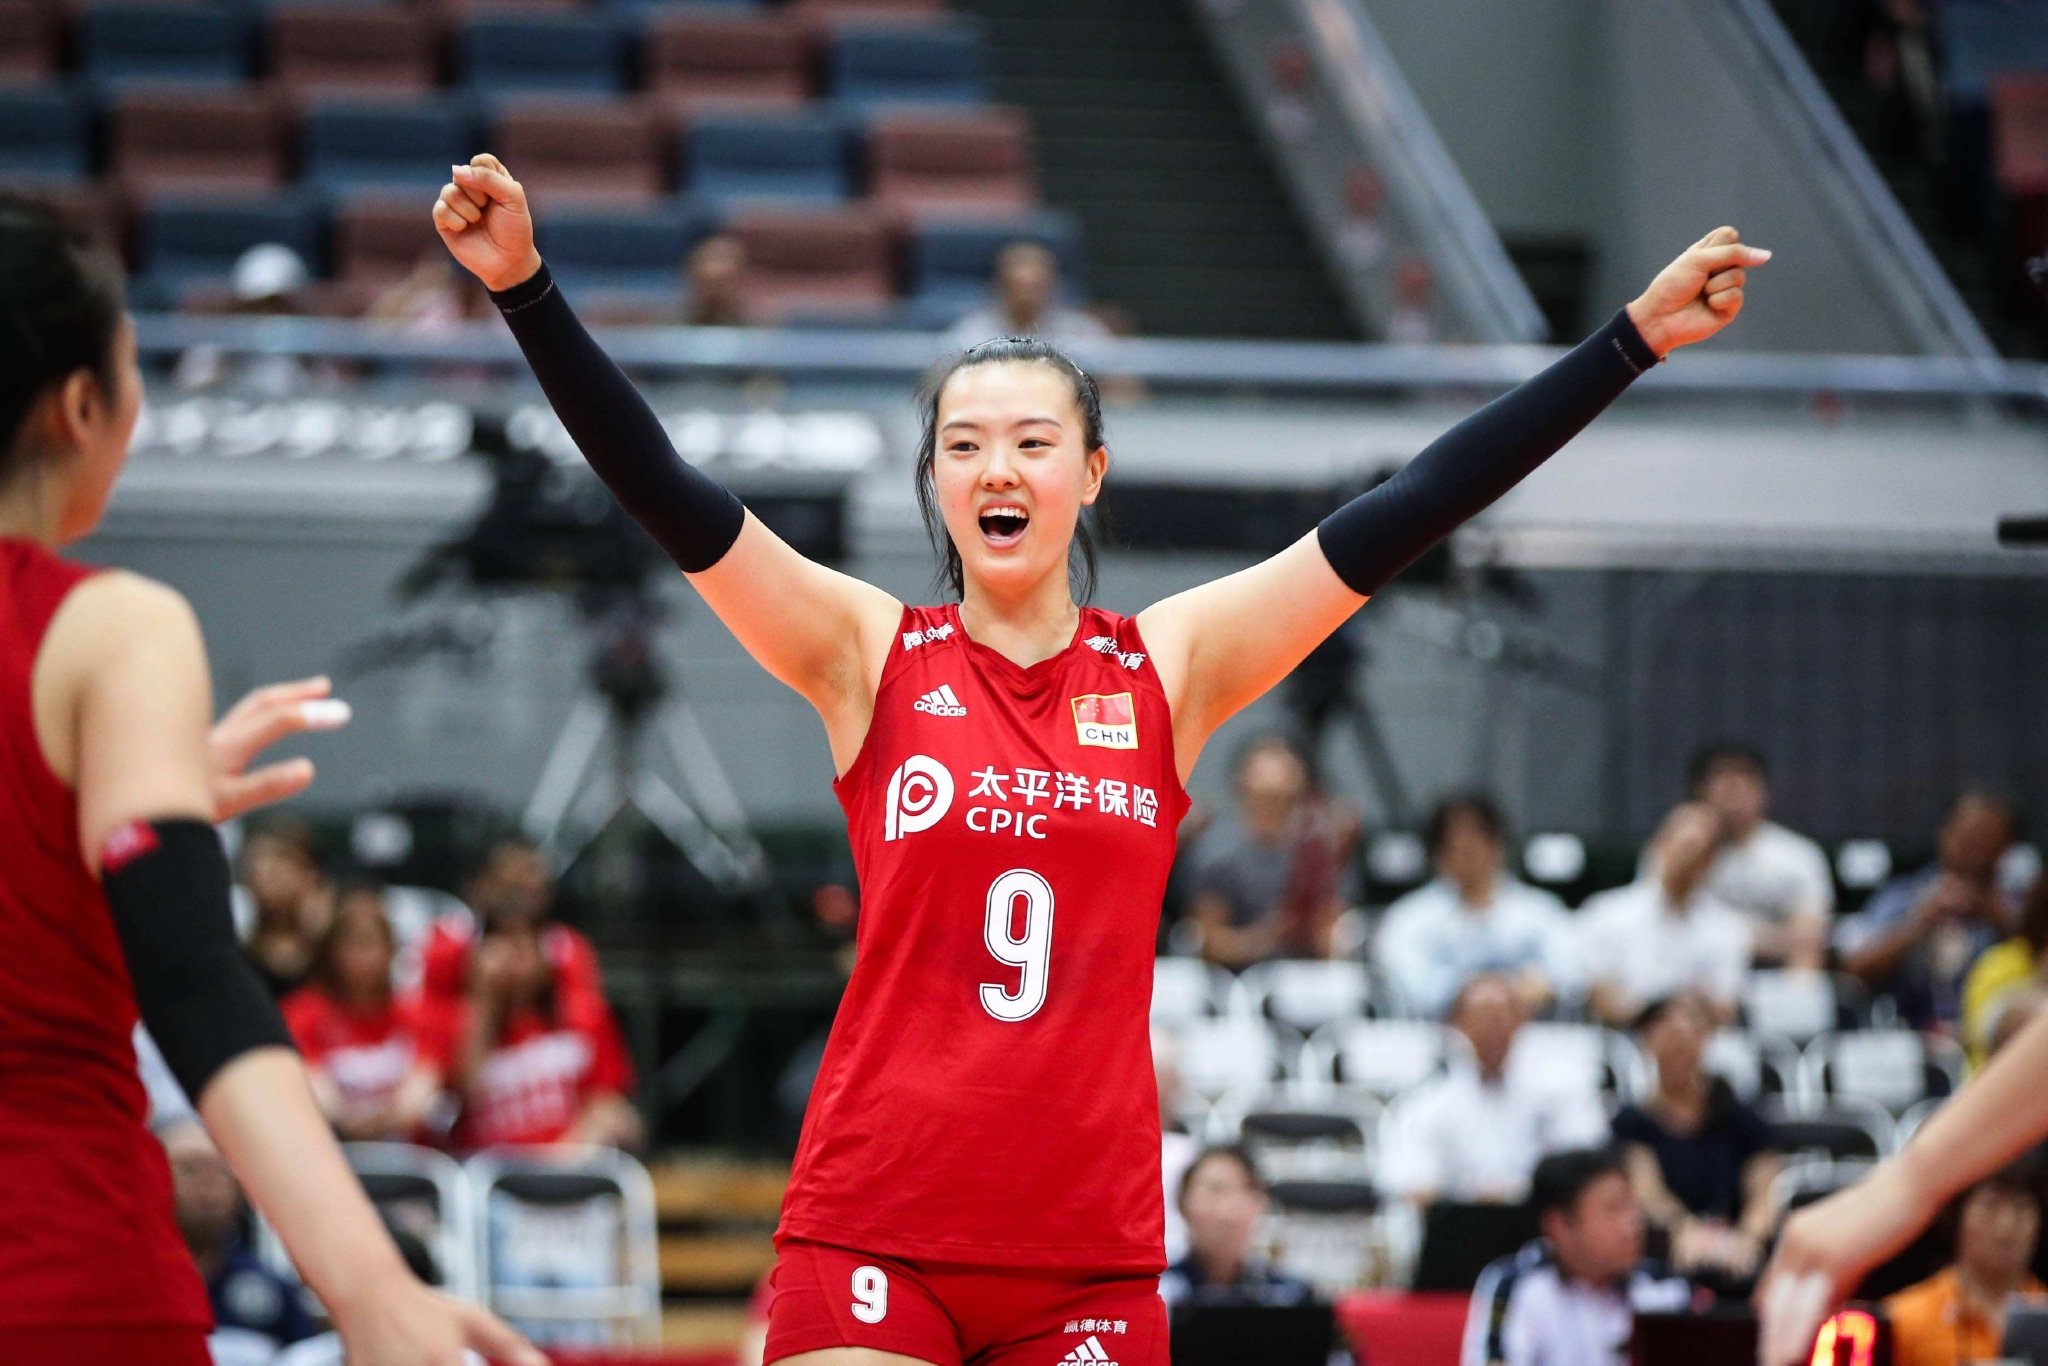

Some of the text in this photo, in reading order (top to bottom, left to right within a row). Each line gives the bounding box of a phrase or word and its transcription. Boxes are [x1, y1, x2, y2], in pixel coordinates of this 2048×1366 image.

[913, 700, 968, 717] adidas
[1085, 728, 1130, 743] CHN
[968, 765, 1159, 828] 太平洋保险
[965, 806, 1048, 839] CPIC
[979, 868, 1055, 1023] 9
[851, 1265, 889, 1324] 9
